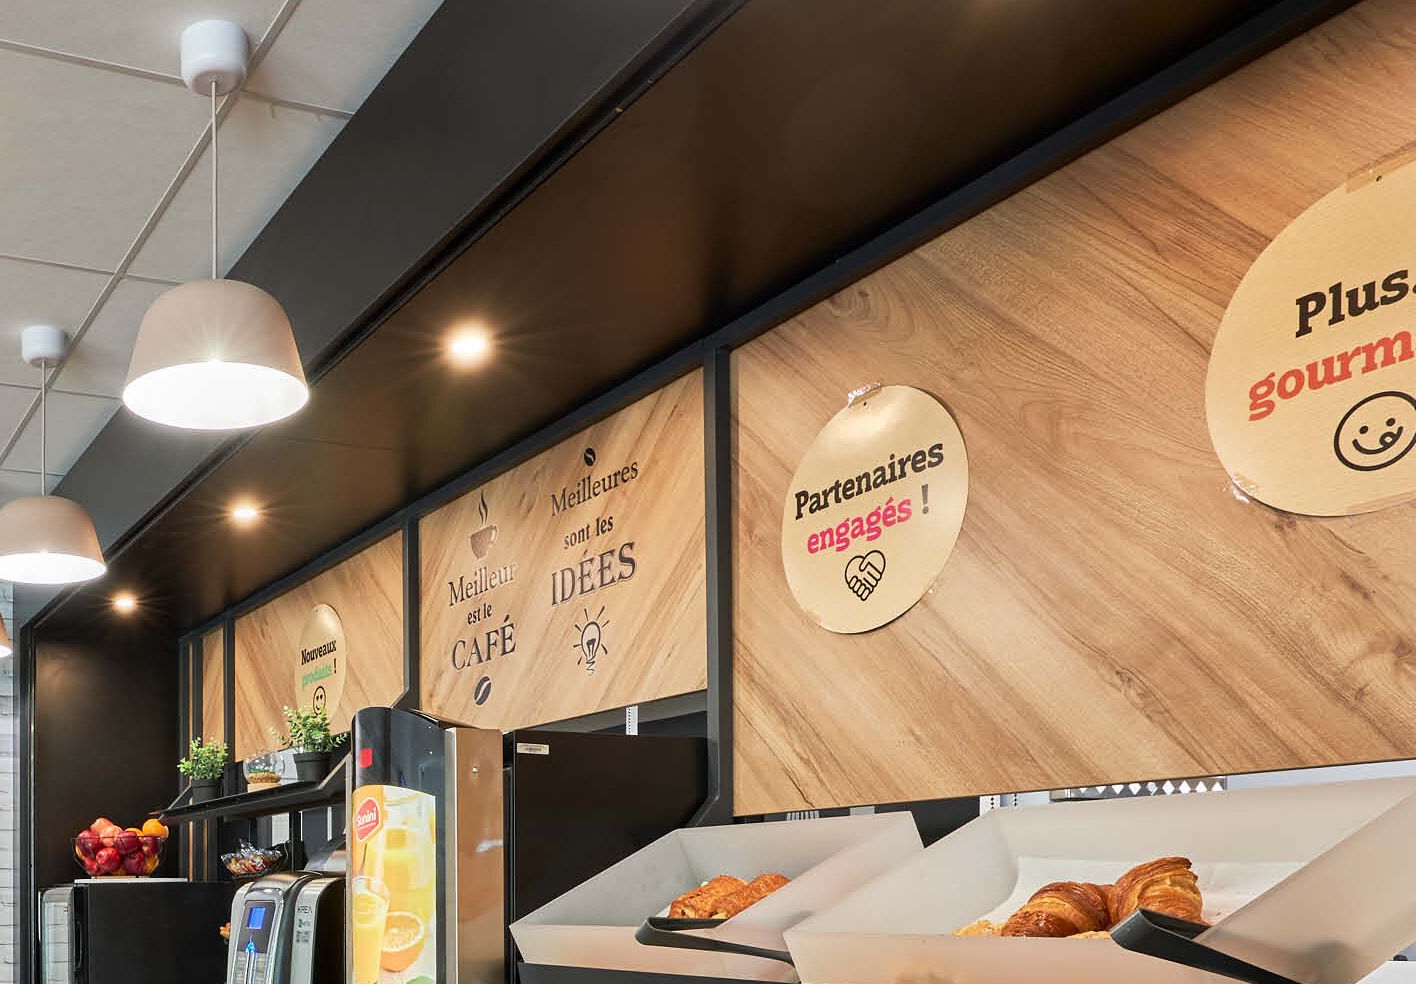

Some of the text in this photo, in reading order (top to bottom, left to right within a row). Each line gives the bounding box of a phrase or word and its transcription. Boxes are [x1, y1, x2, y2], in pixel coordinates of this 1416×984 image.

[550, 461, 639, 517] Meilleures
[794, 443, 944, 521] Partenaires
[564, 515, 615, 550] sont les
[807, 483, 930, 554] engagés !
[448, 563, 516, 607] Meilleur
[551, 540, 636, 606] IDÉES
[452, 613, 517, 671] CAFÉ
[467, 602, 493, 626] est le
[301, 640, 337, 666] Nouveaux
